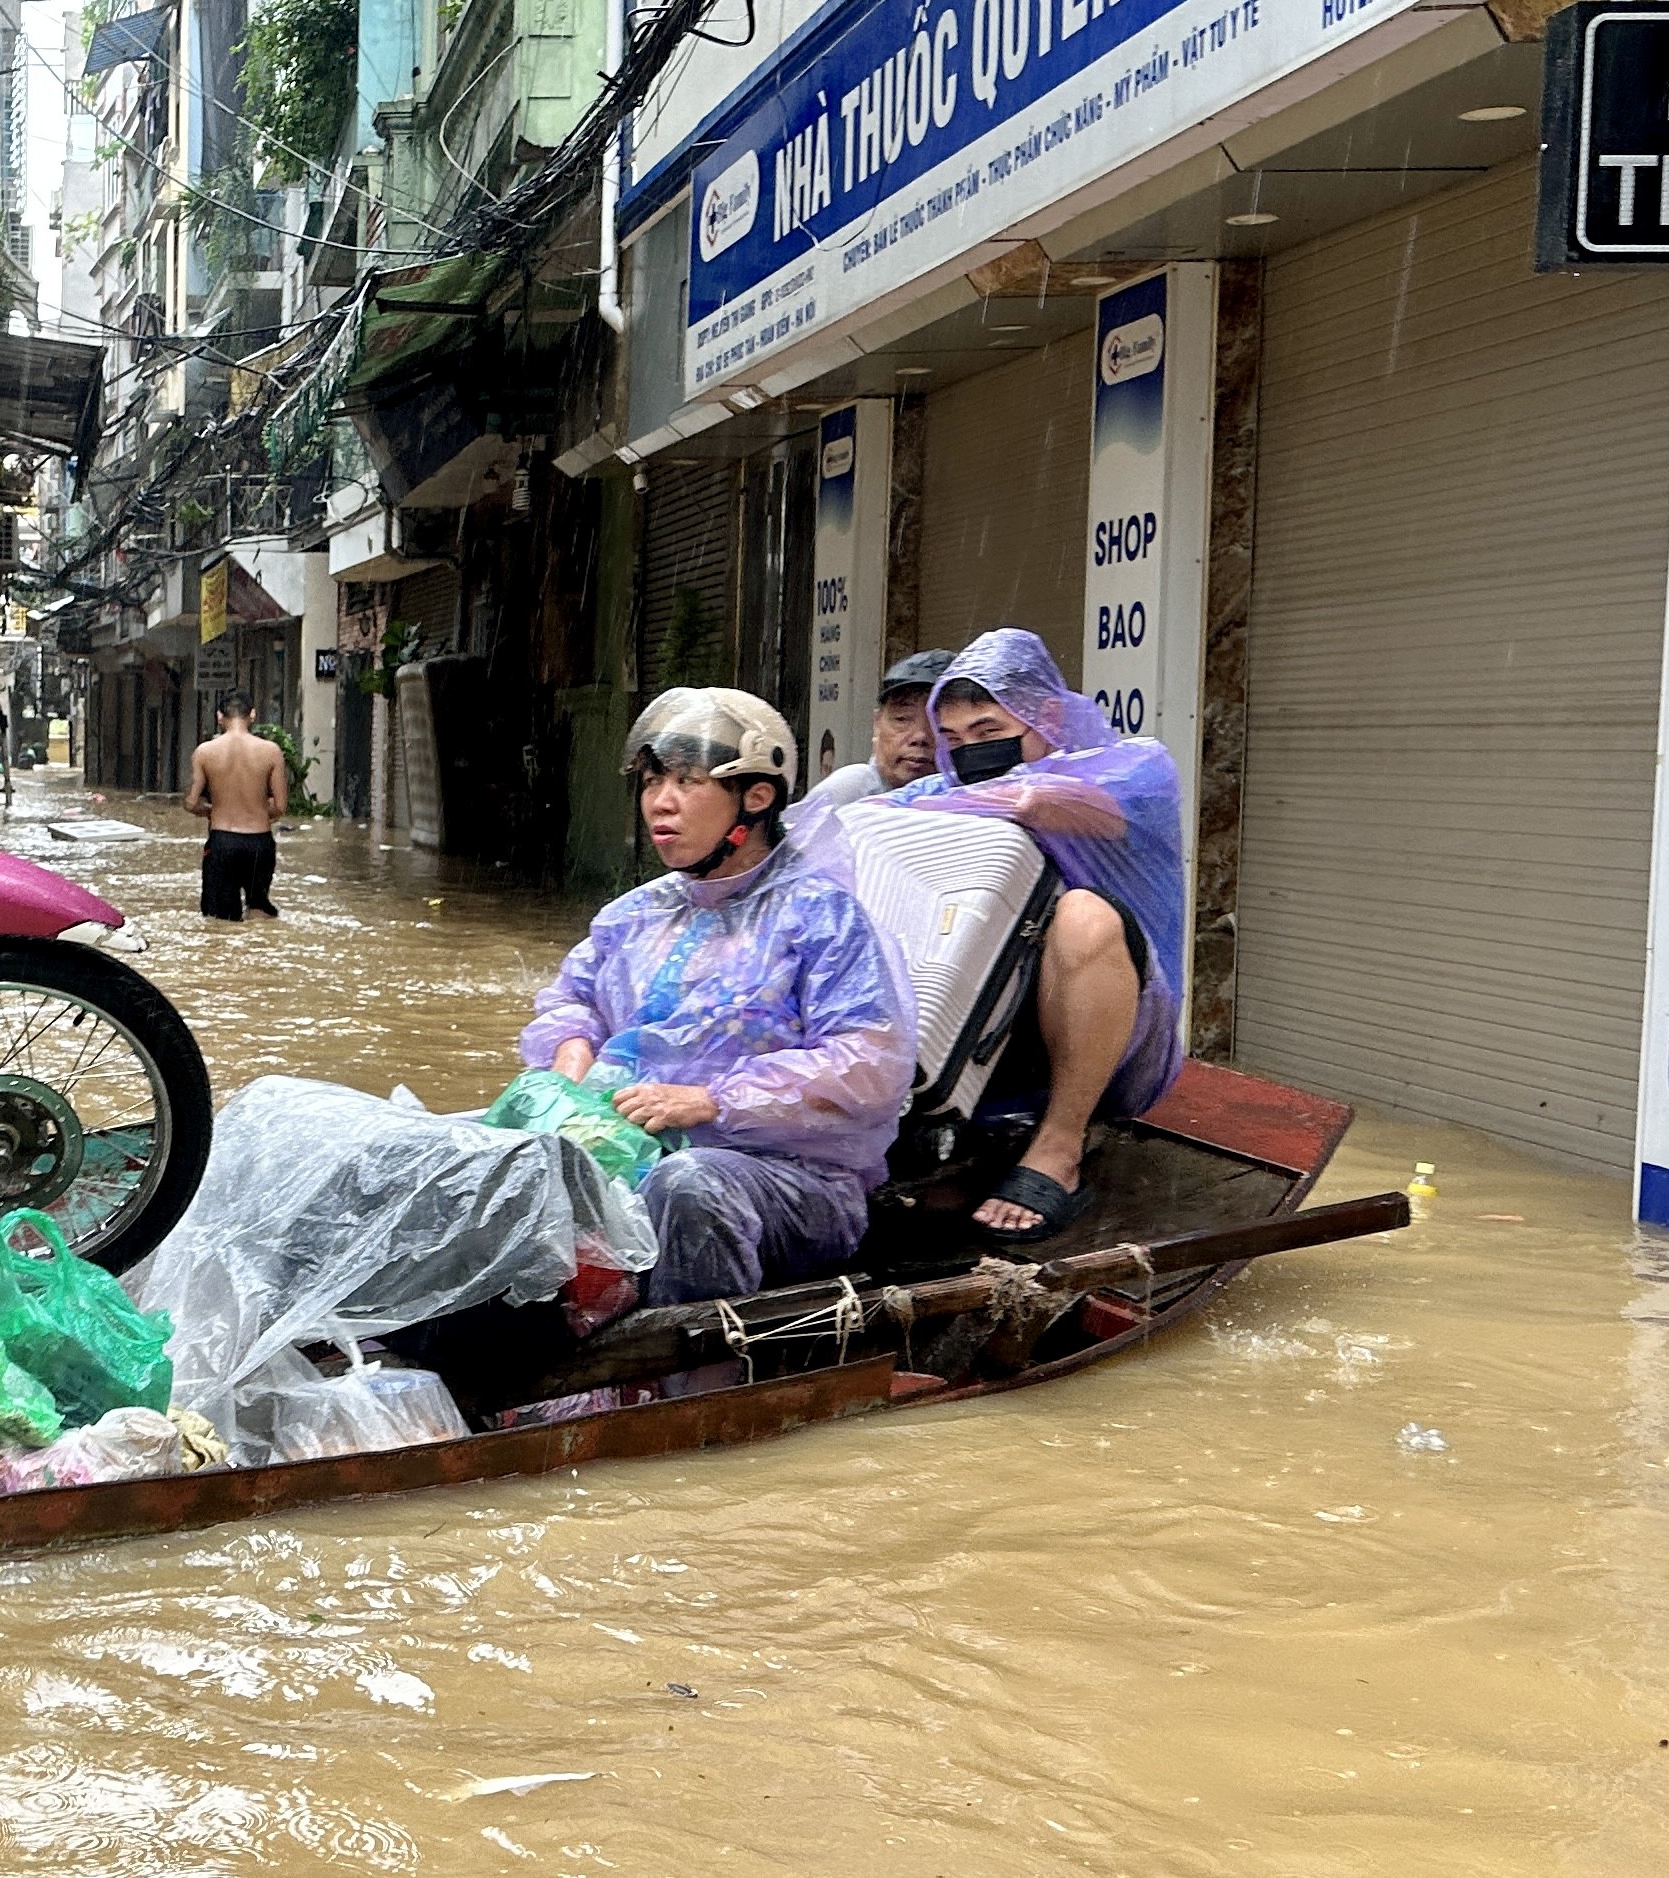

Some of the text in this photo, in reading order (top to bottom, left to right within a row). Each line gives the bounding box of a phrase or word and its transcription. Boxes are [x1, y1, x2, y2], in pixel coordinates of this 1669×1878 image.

[1134, 43, 1169, 98] PHẨM
[1182, 26, 1206, 70] VẬT
[1231, 7, 1240, 39] Y
[773, 90, 831, 243] NHÀ
[841, 0, 958, 193] THUỐC
[1599, 154, 1669, 226] T
[1095, 512, 1157, 567] SHOP
[817, 577, 848, 616] 100%
[1097, 601, 1146, 650] BAO
